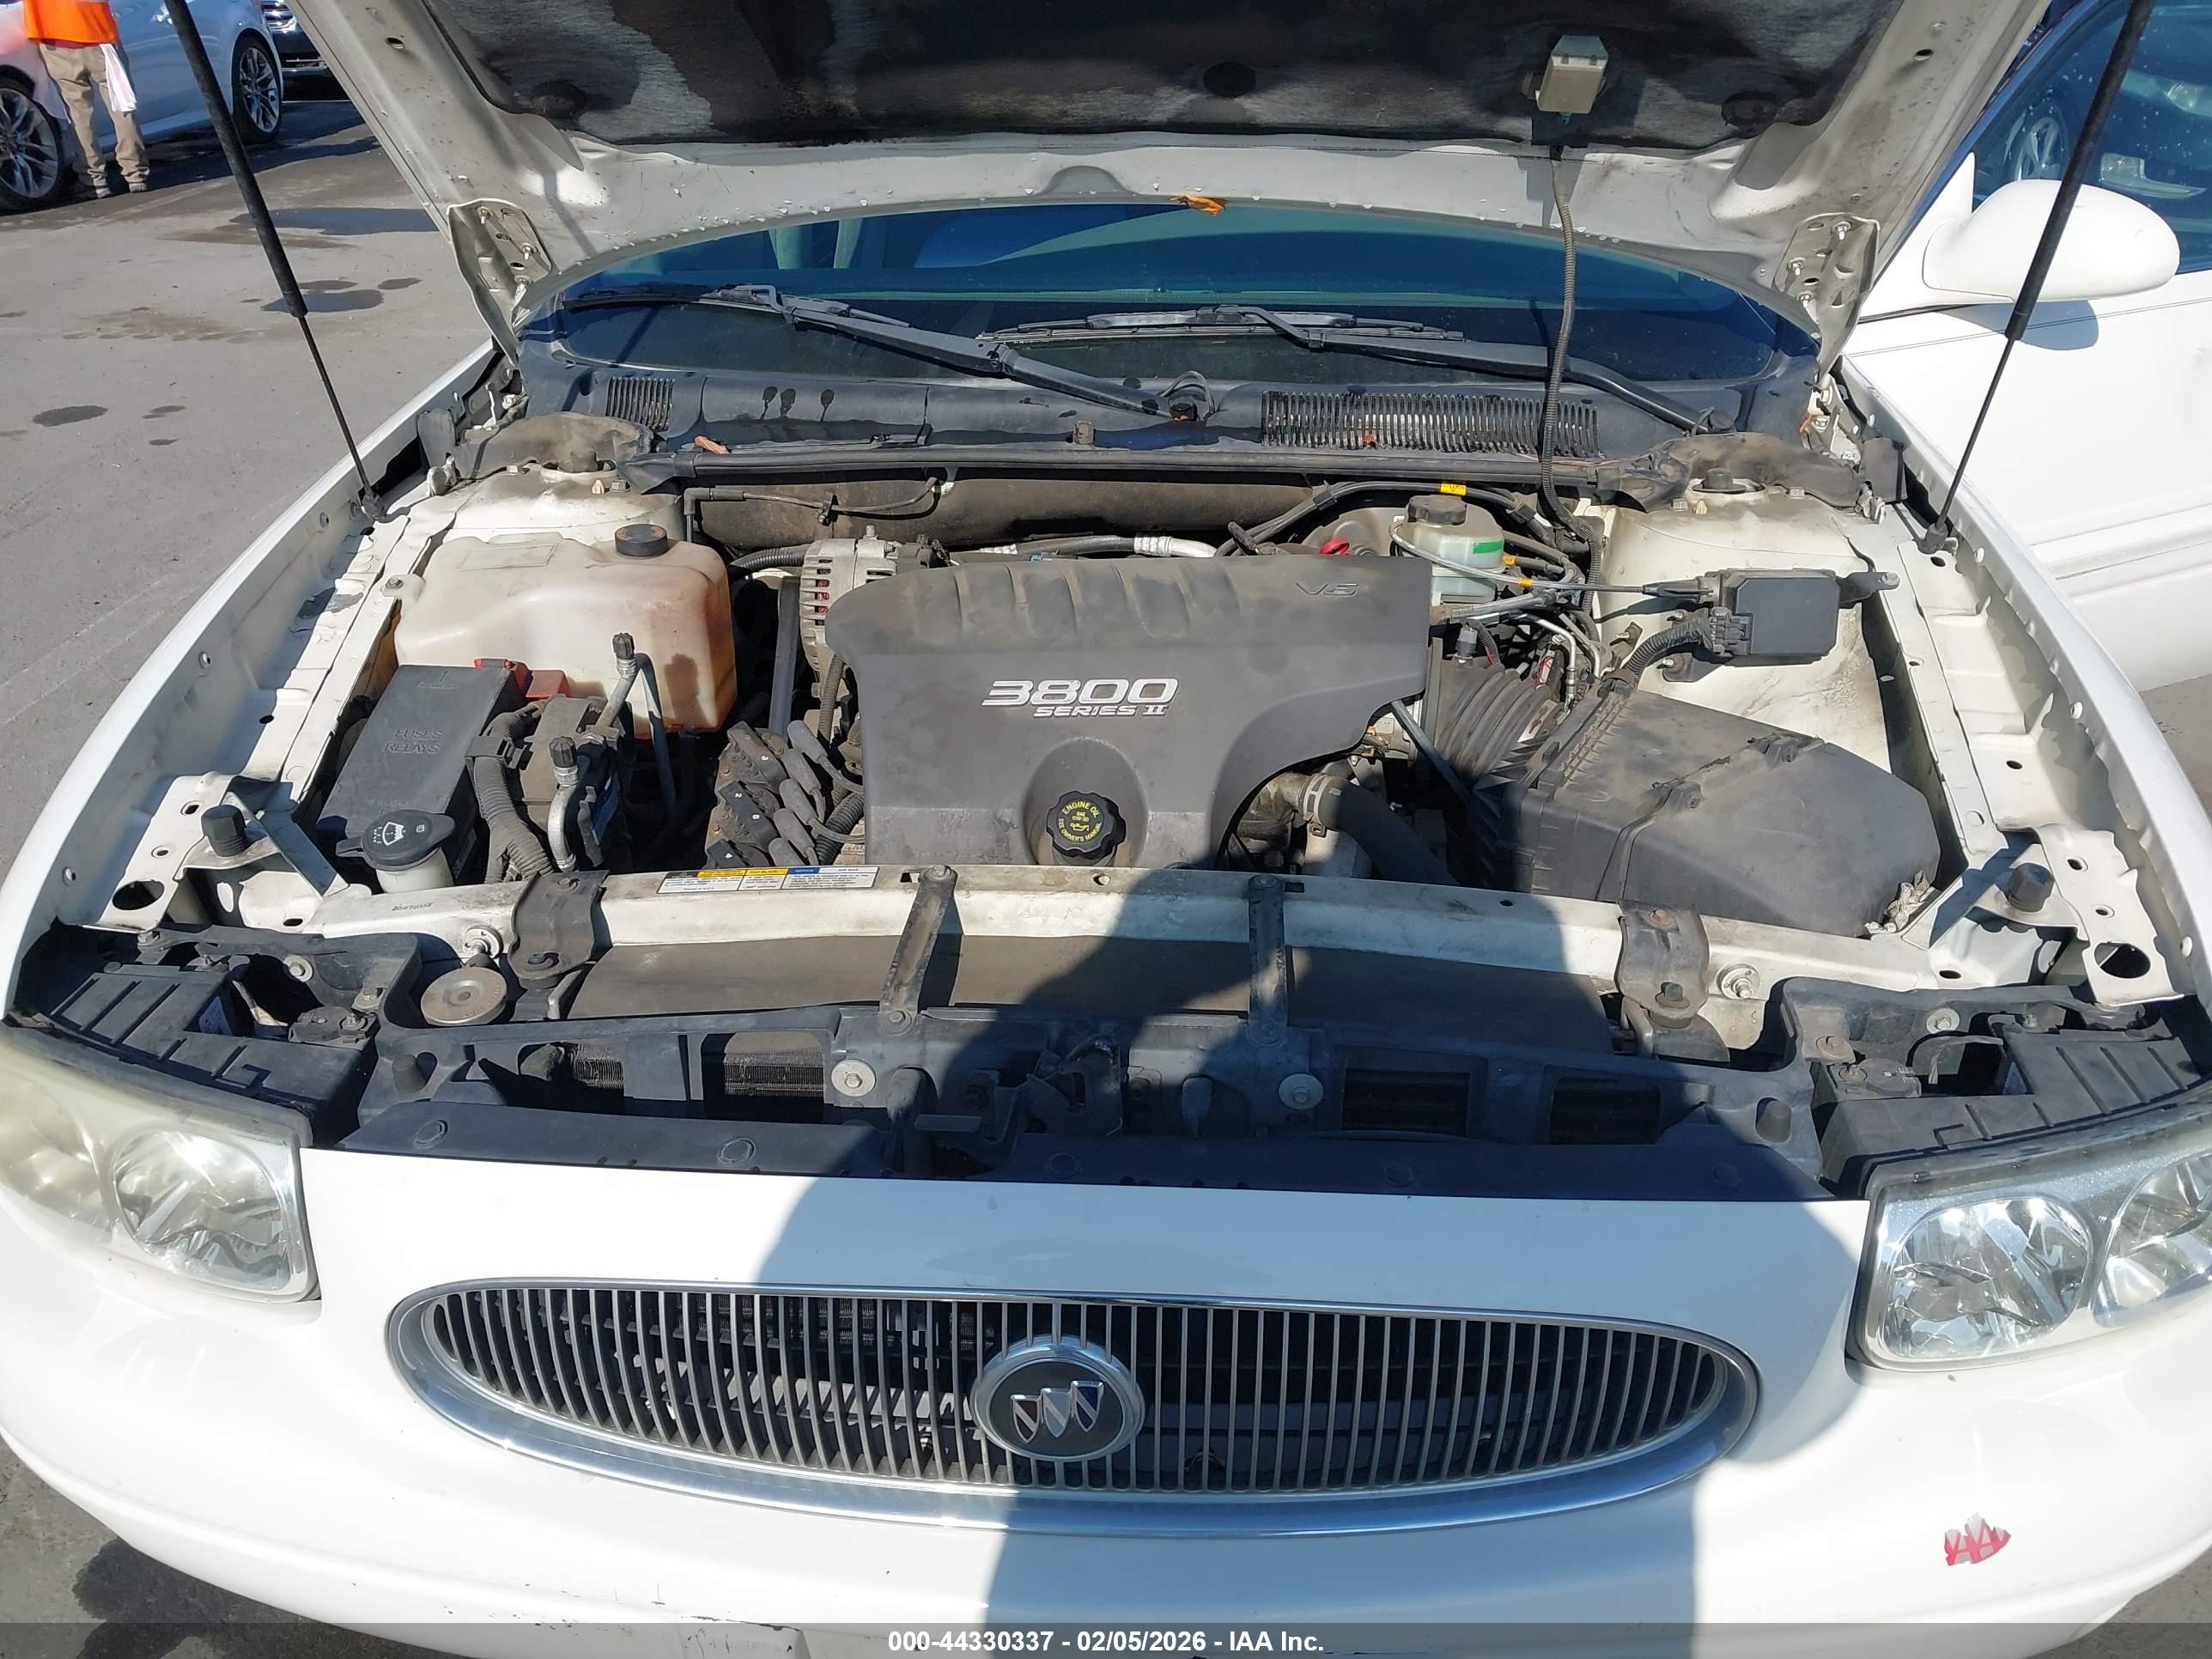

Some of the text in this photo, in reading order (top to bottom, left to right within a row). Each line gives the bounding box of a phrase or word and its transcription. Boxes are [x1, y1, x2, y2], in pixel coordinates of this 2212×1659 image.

[1294, 582, 1359, 598] V6
[981, 678, 1179, 706] 3800
[1033, 704, 1169, 717] SERIES II
[396, 728, 444, 740] FUSES
[384, 742, 441, 755] RELAYS
[1061, 801, 1100, 818] ENGINE OIL
[1085, 822, 1102, 840] MANUAL
